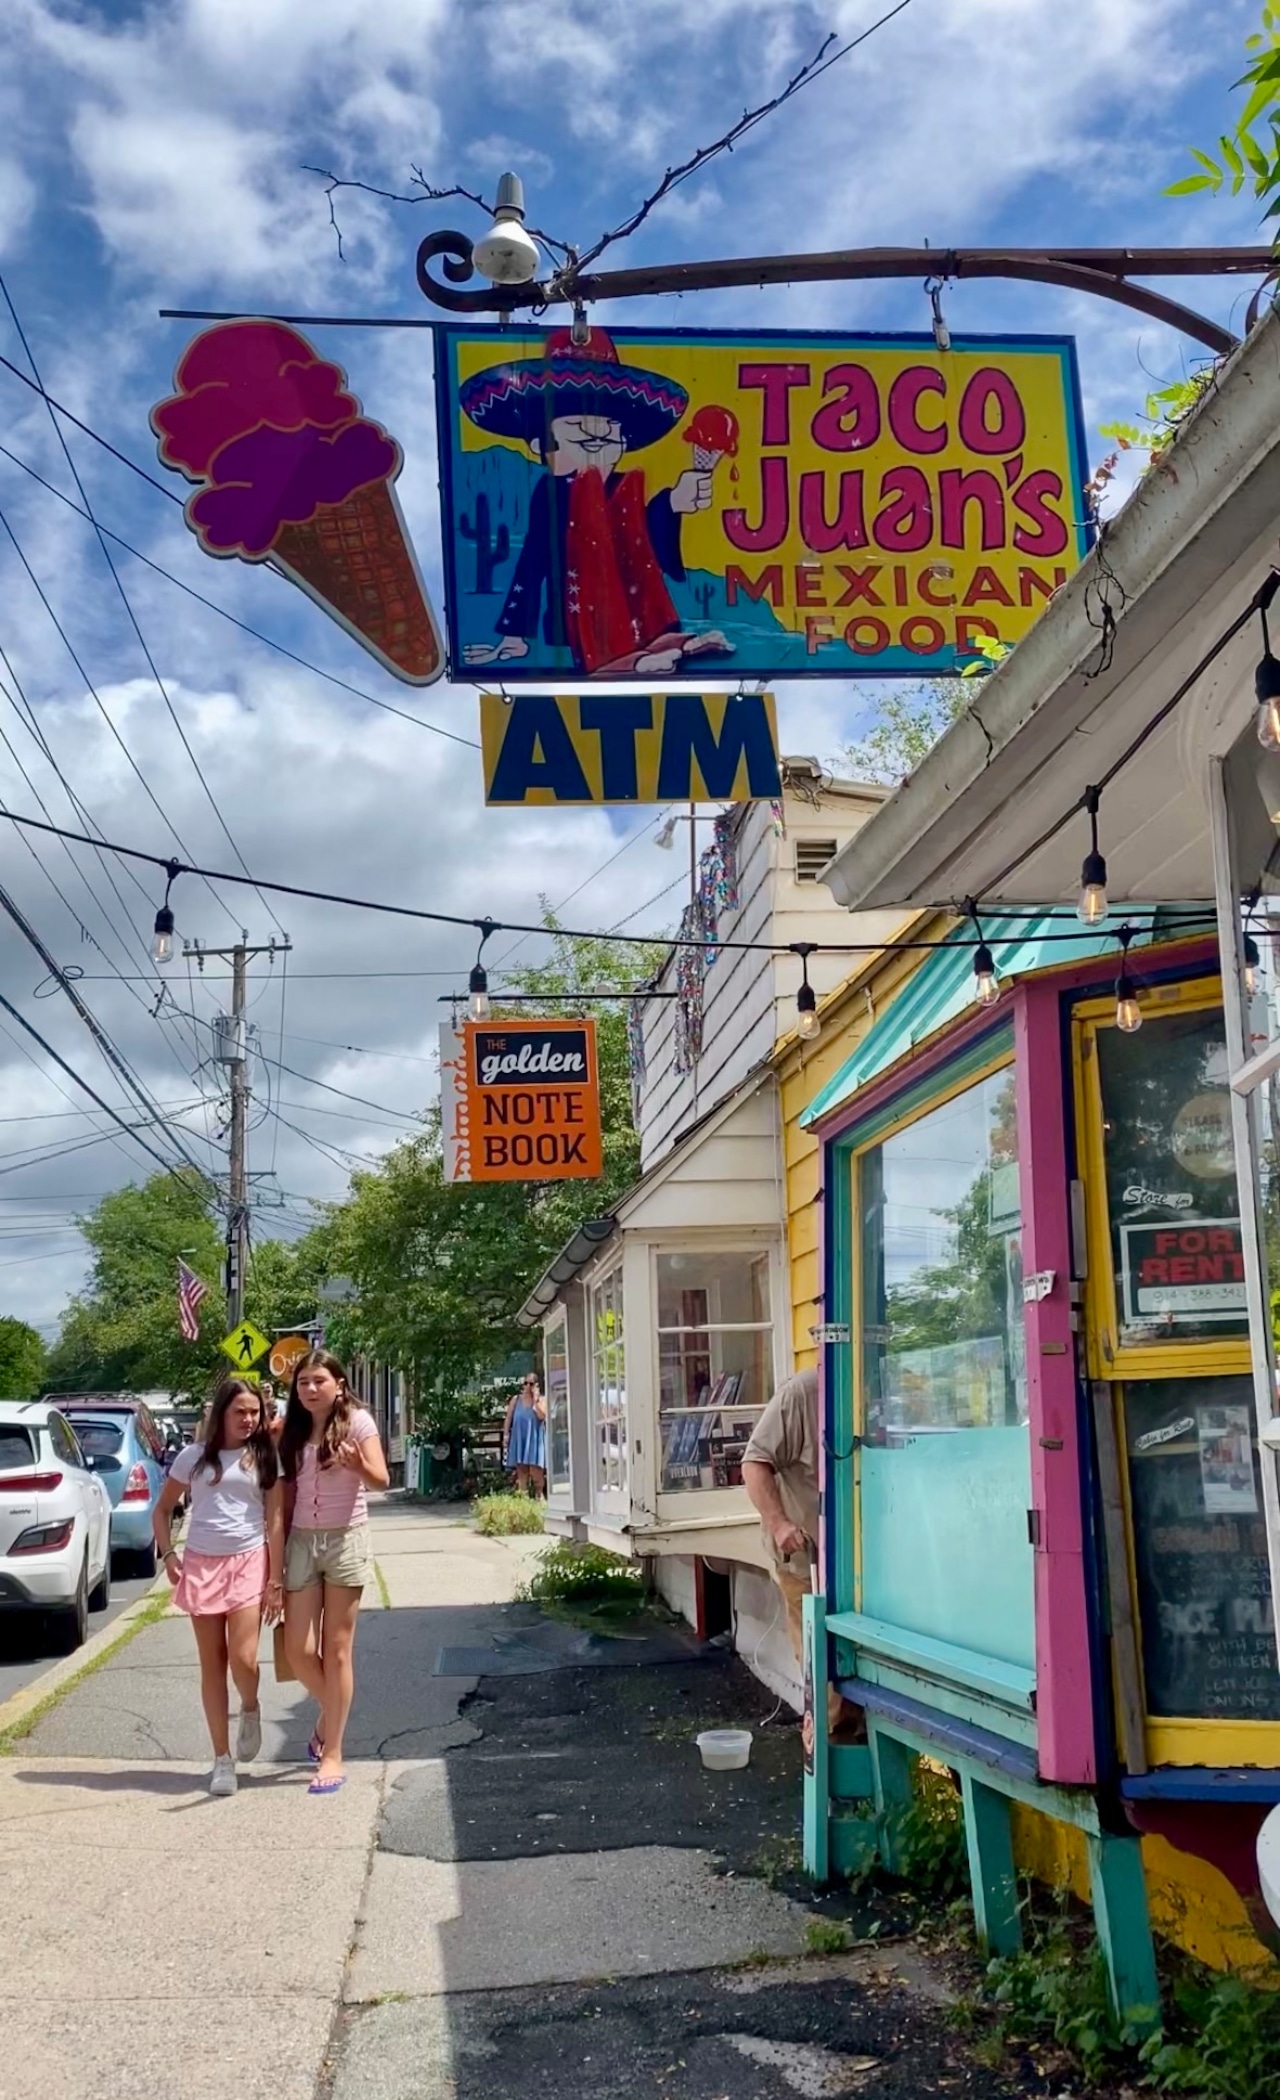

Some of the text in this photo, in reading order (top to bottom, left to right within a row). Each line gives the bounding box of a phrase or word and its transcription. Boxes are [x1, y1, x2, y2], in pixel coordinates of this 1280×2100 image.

[739, 363, 1027, 455] Taco
[722, 453, 1068, 558] Juan's
[725, 564, 1067, 608] MEXICAN
[806, 615, 1000, 656] FOOD
[488, 695, 781, 801] ATM
[481, 1042, 585, 1084] golden
[486, 1039, 507, 1051] THE
[483, 1092, 584, 1126] NOTE
[483, 1133, 588, 1167] BOOK
[1155, 1227, 1234, 1255] FOR
[1142, 1252, 1243, 1284] RENT
